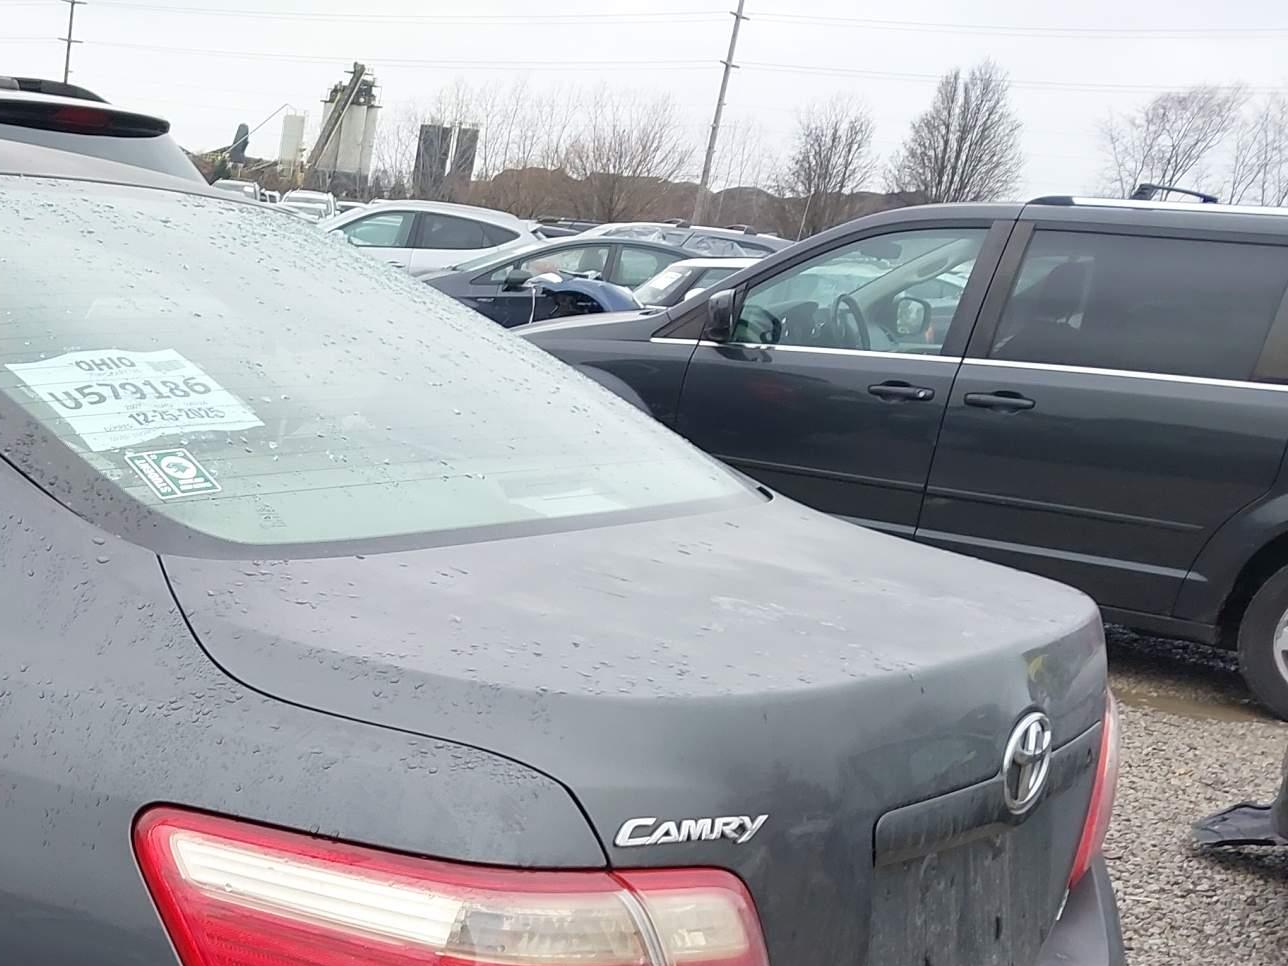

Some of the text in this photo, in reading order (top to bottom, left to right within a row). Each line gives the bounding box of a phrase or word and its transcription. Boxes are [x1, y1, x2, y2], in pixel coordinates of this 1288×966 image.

[74, 356, 137, 373] OHIO
[48, 376, 213, 411] U579186
[128, 406, 227, 427] 12-25-2025
[614, 814, 769, 847] CAMRY
